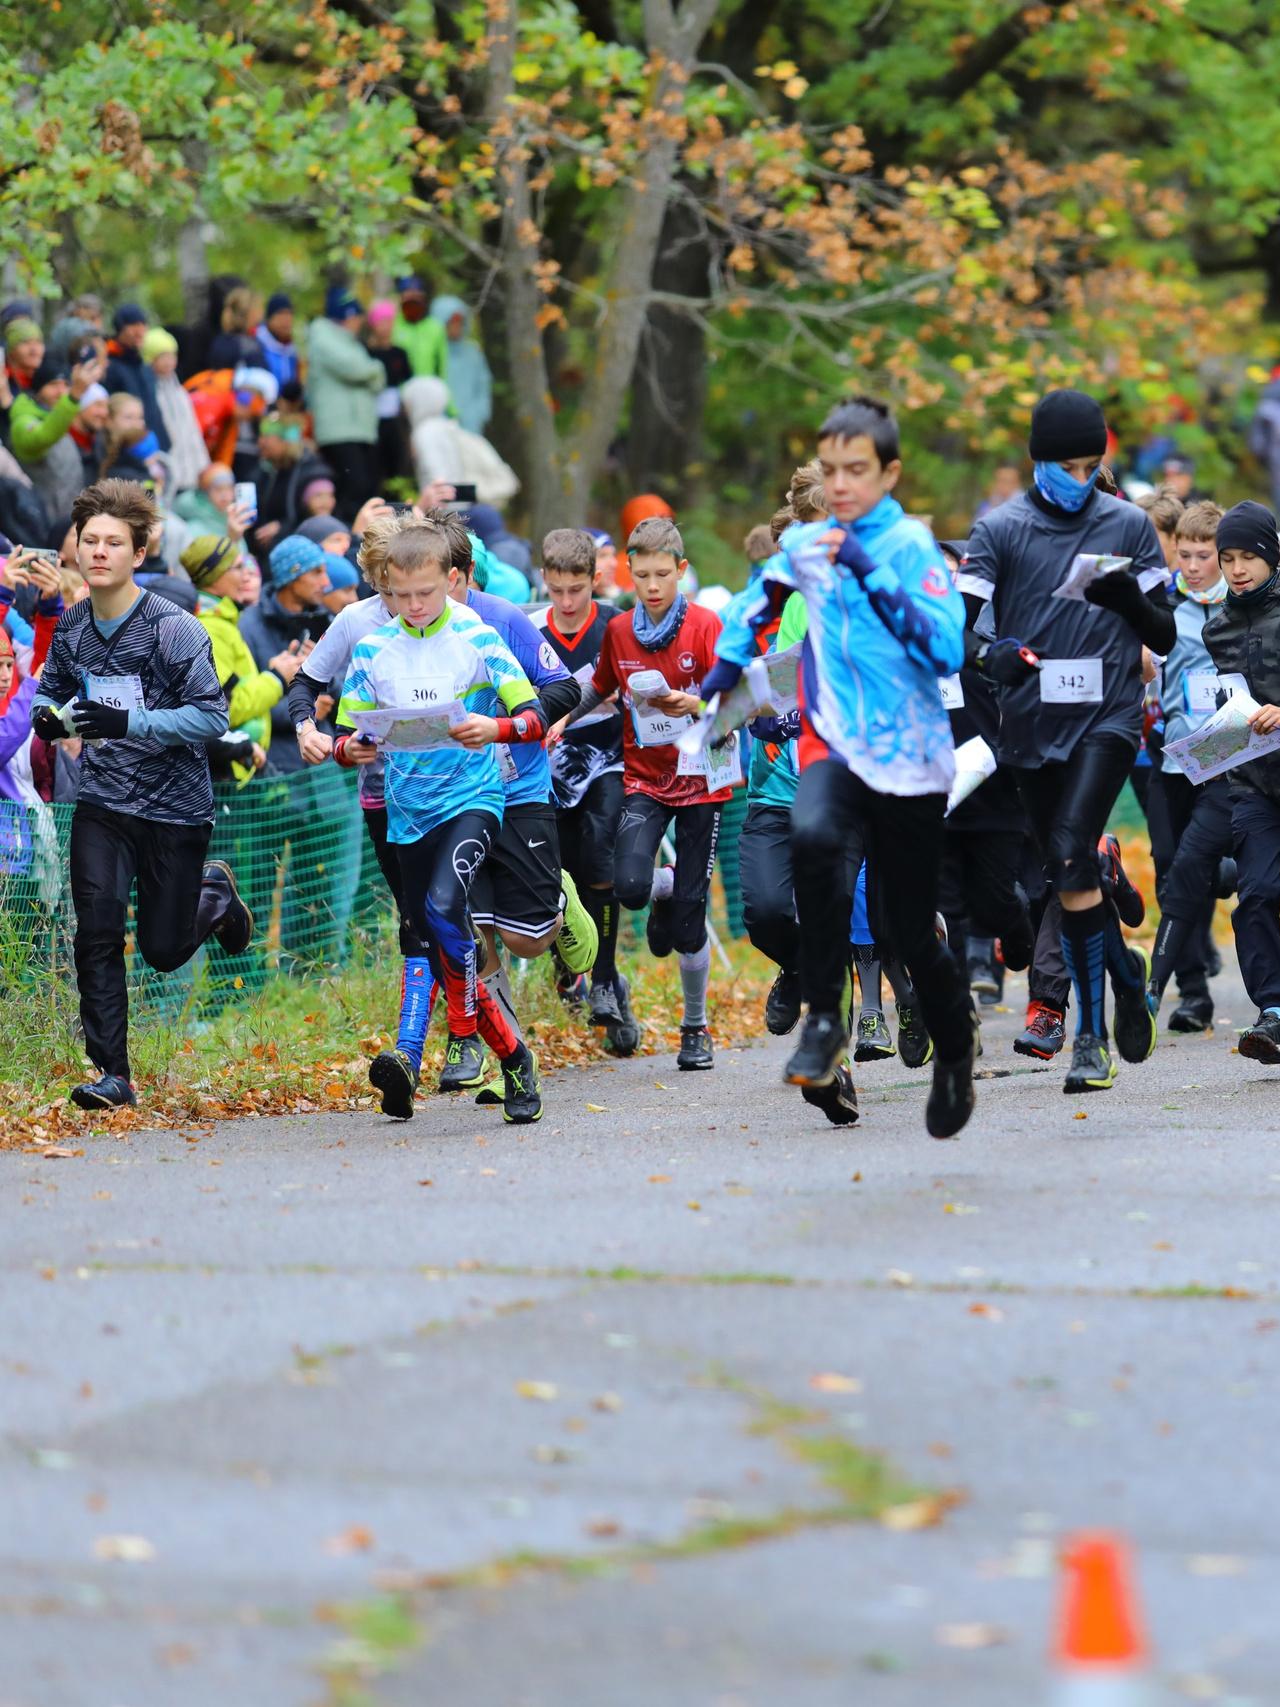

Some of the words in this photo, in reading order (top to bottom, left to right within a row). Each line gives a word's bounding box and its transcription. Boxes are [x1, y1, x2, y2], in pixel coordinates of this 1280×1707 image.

[1058, 675, 1085, 689] 342
[411, 688, 437, 702] 306
[1203, 687, 1219, 699] 33
[99, 696, 122, 709] 356
[649, 721, 672, 734] 305
